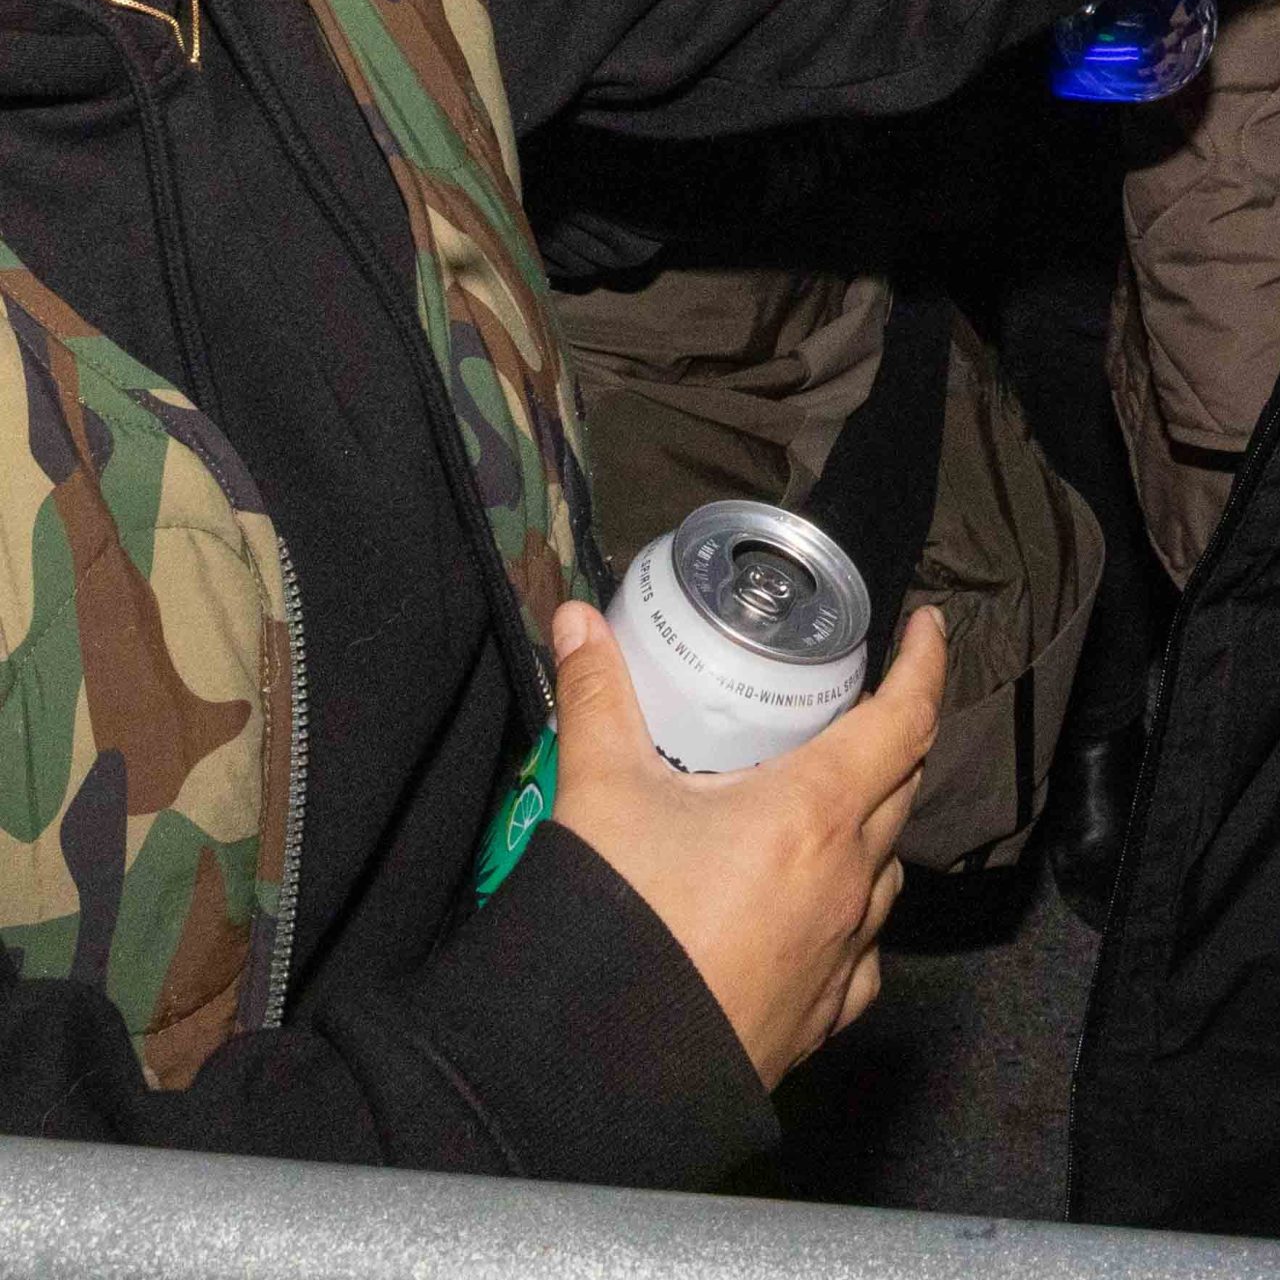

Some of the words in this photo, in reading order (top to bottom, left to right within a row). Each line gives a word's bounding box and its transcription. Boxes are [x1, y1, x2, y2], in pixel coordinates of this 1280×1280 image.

[639, 559, 654, 603] SPIRITS
[650, 609, 678, 646] MADE
[674, 641, 705, 674] WITH
[707, 667, 815, 707] ARD-WINNING
[816, 686, 842, 706] REAL
[843, 654, 867, 693] SPIRIT
